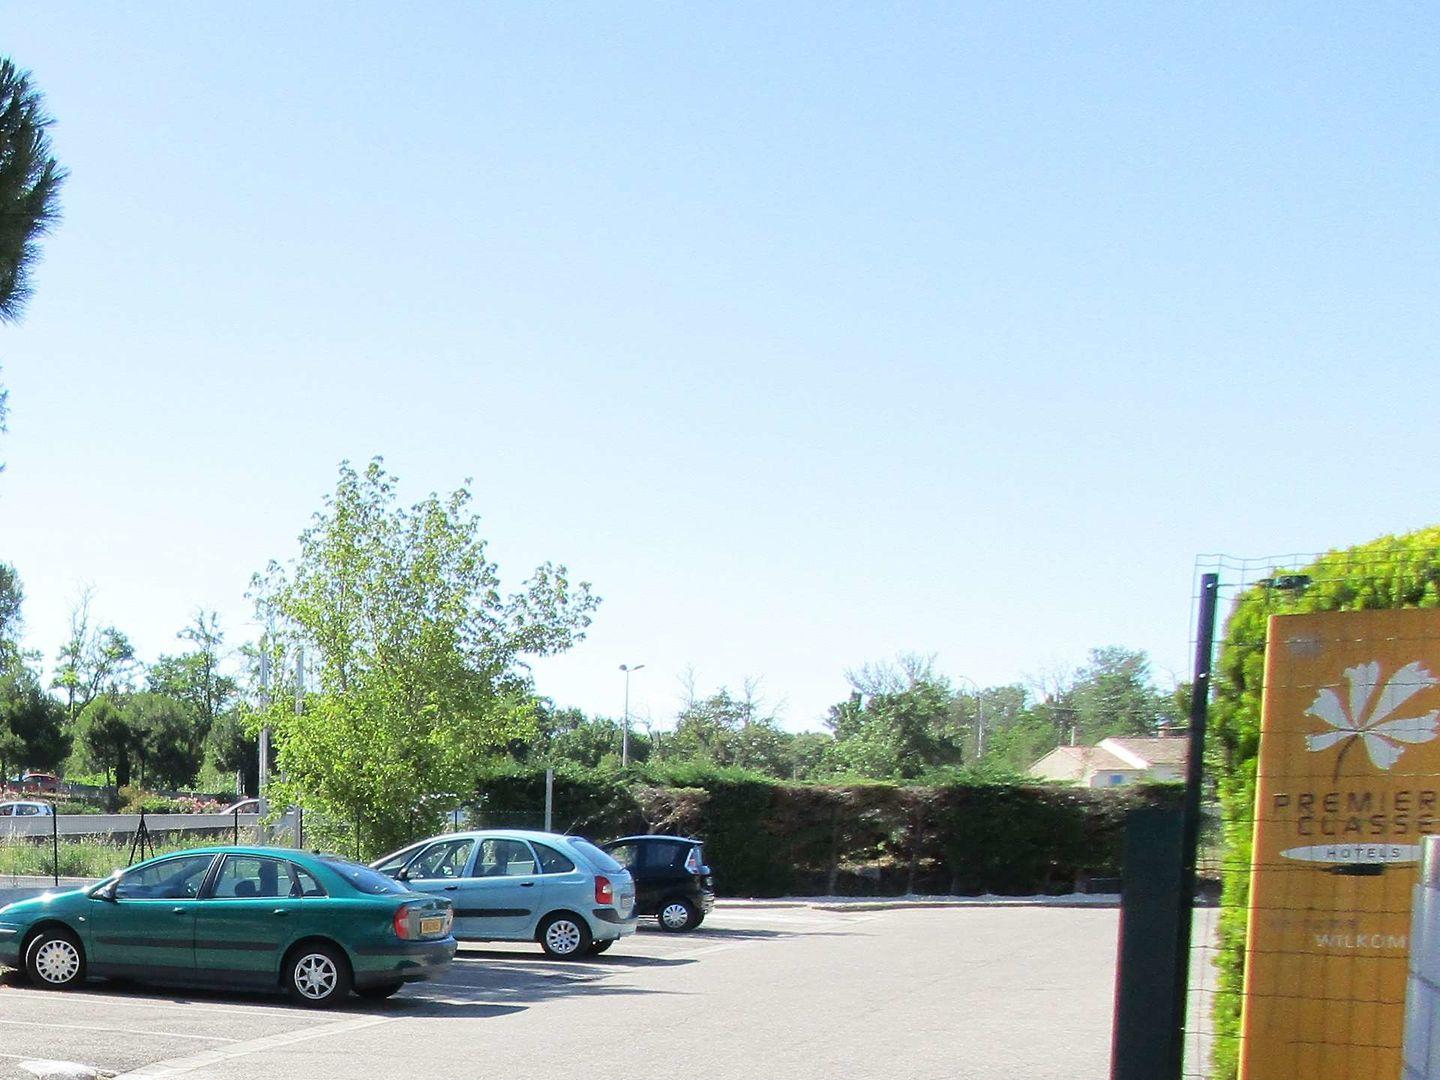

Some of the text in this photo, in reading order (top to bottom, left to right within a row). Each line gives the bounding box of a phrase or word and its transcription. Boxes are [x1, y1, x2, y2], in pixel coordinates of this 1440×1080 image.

[1273, 790, 1437, 815] PREMIER
[1297, 813, 1435, 836] CLASSE
[1326, 847, 1401, 859] HOTELS
